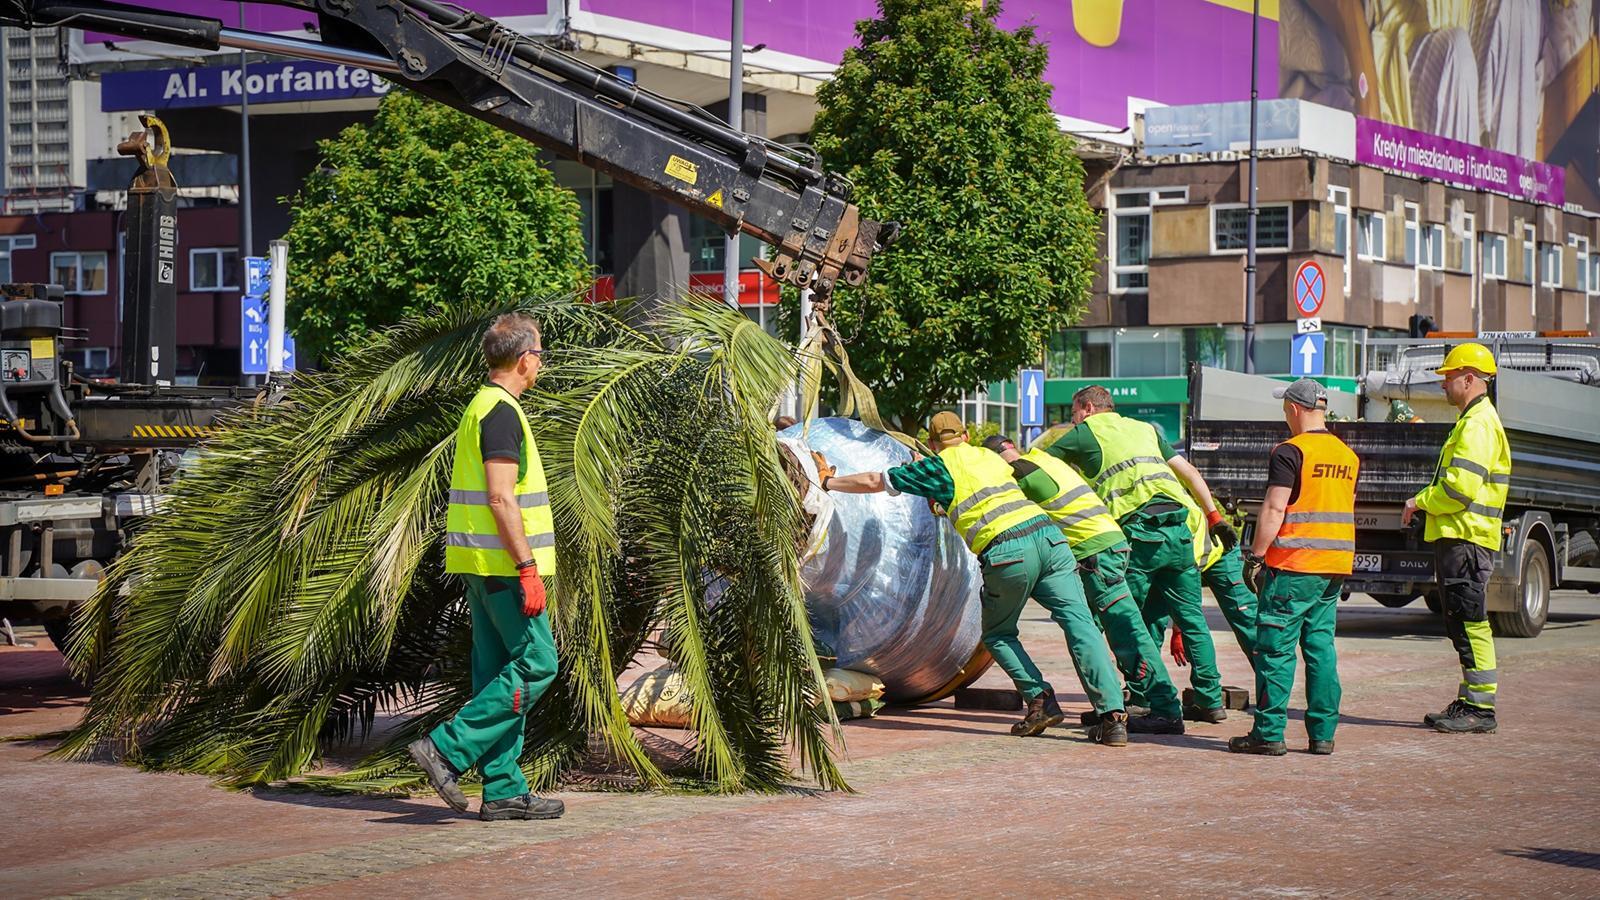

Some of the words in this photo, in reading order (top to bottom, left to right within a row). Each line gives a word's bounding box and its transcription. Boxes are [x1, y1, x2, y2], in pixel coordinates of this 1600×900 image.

[163, 73, 208, 99] Al.
[1373, 132, 1407, 168] Kredyty
[1408, 142, 1465, 176] mieszkaniowe
[1466, 154, 1470, 177] i
[1470, 155, 1508, 185] Fundusze
[160, 215, 174, 259] HIAB
[1311, 463, 1353, 481] STIHL
[1354, 517, 1378, 527] CAR
[1354, 554, 1379, 568] 959
